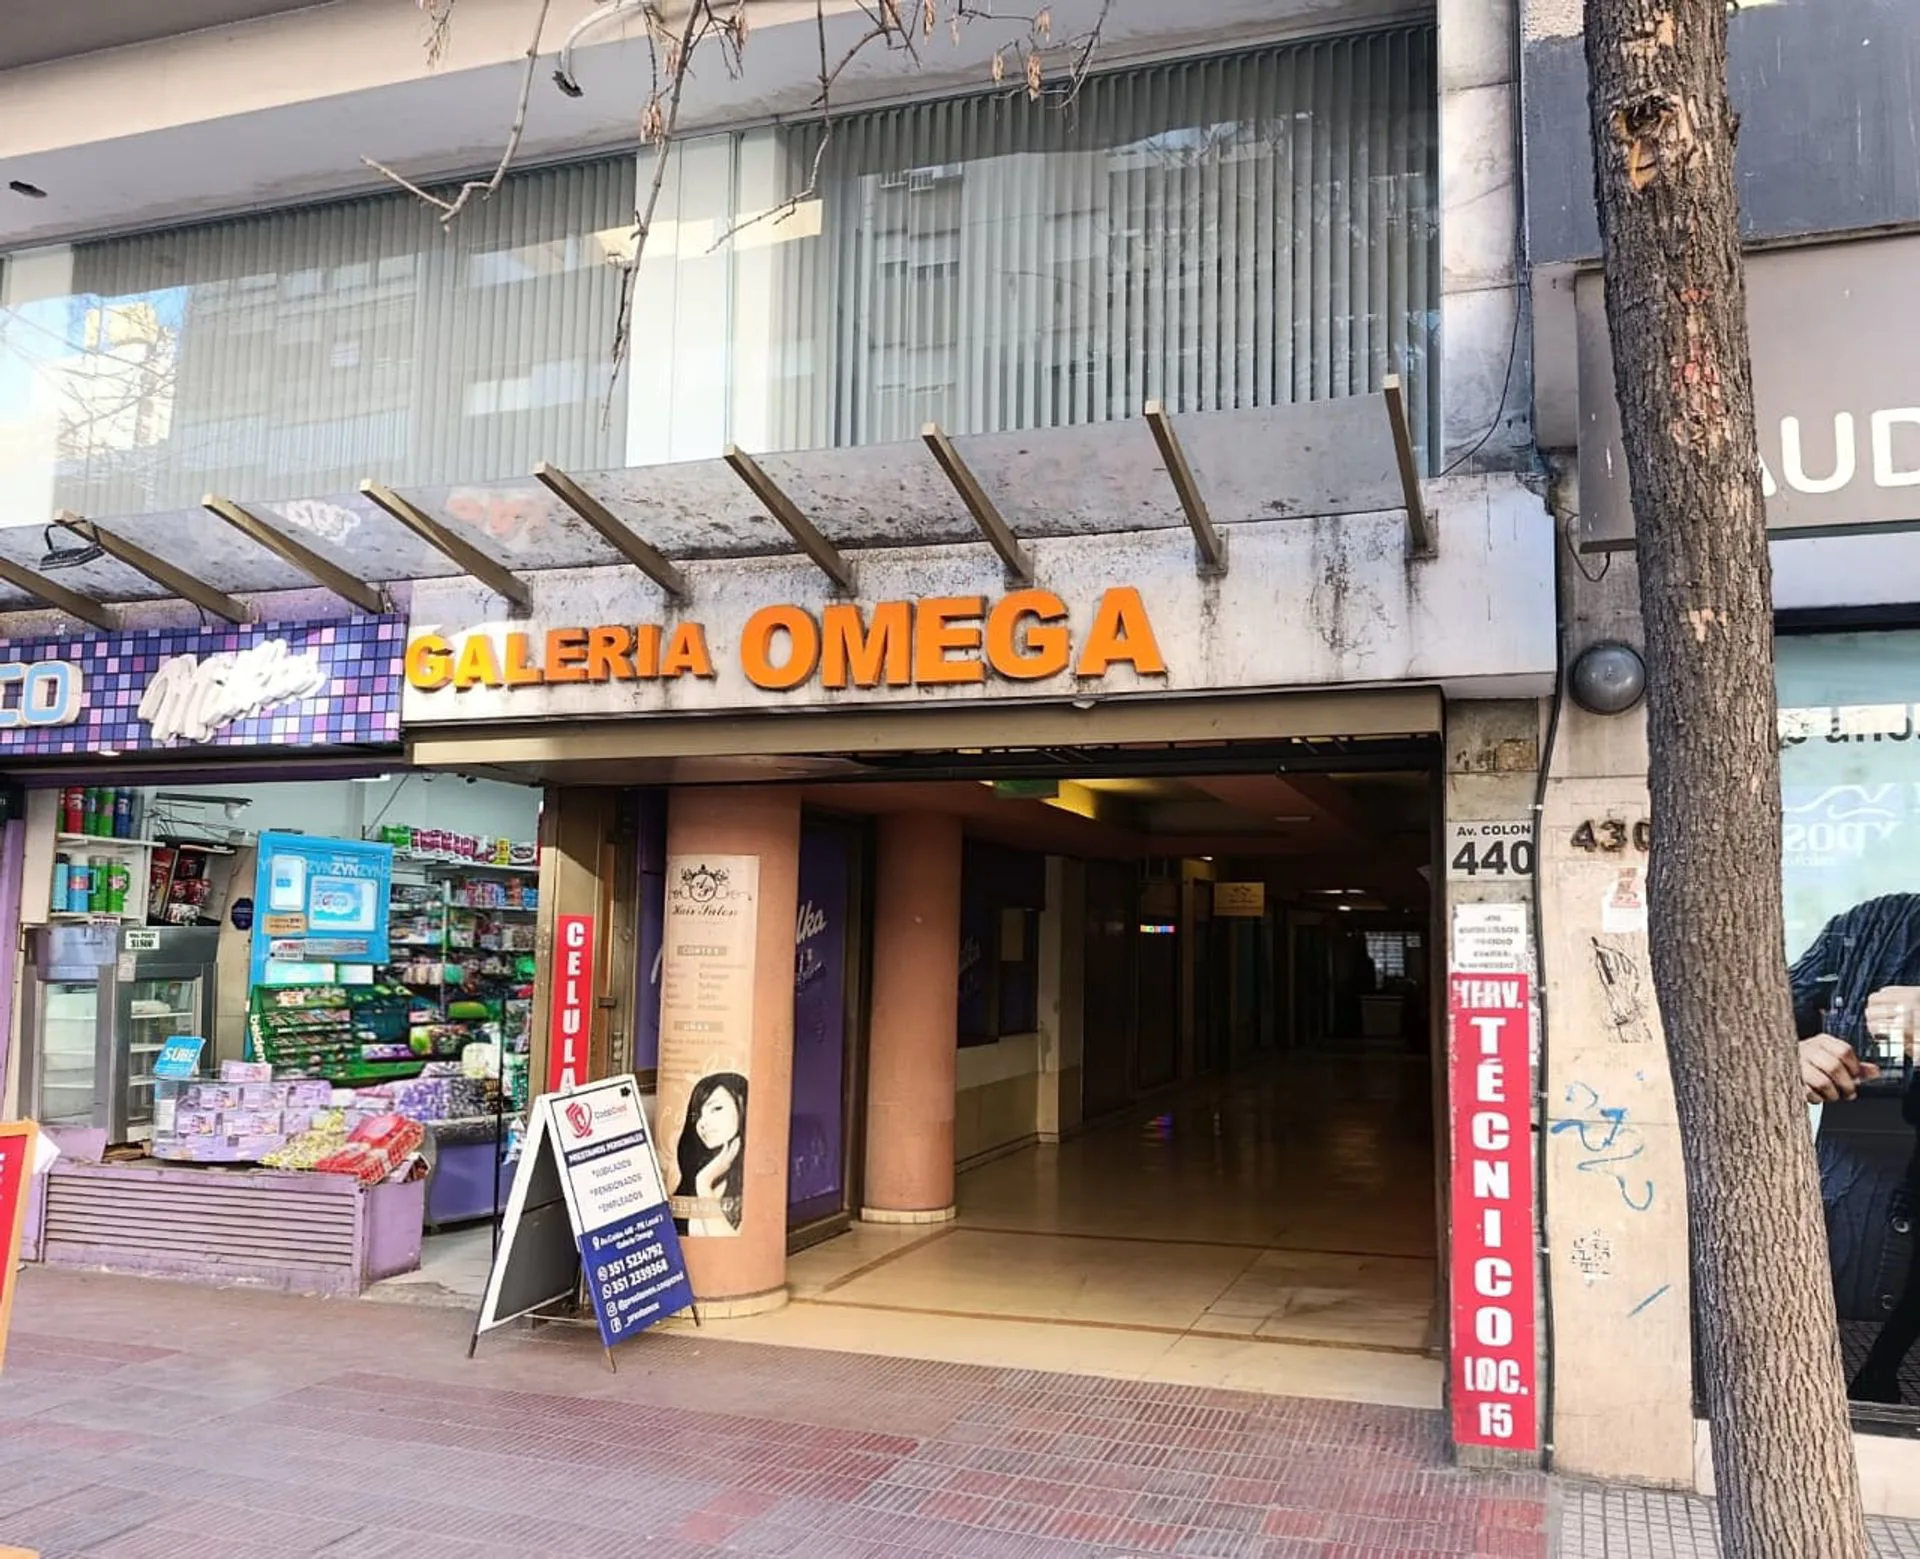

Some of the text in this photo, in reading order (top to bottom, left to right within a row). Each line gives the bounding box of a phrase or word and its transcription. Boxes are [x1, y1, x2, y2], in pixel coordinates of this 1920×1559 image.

[1757, 406, 1920, 498] UD
[404, 586, 1166, 692] GALERIA OMEGA
[1457, 824, 1531, 837] Av. COLON
[1570, 819, 1651, 853] 430
[1452, 840, 1533, 875] 440
[607, 1259, 626, 1277] 351
[611, 1276, 630, 1294] 351
[1479, 1401, 1513, 1438] 15
